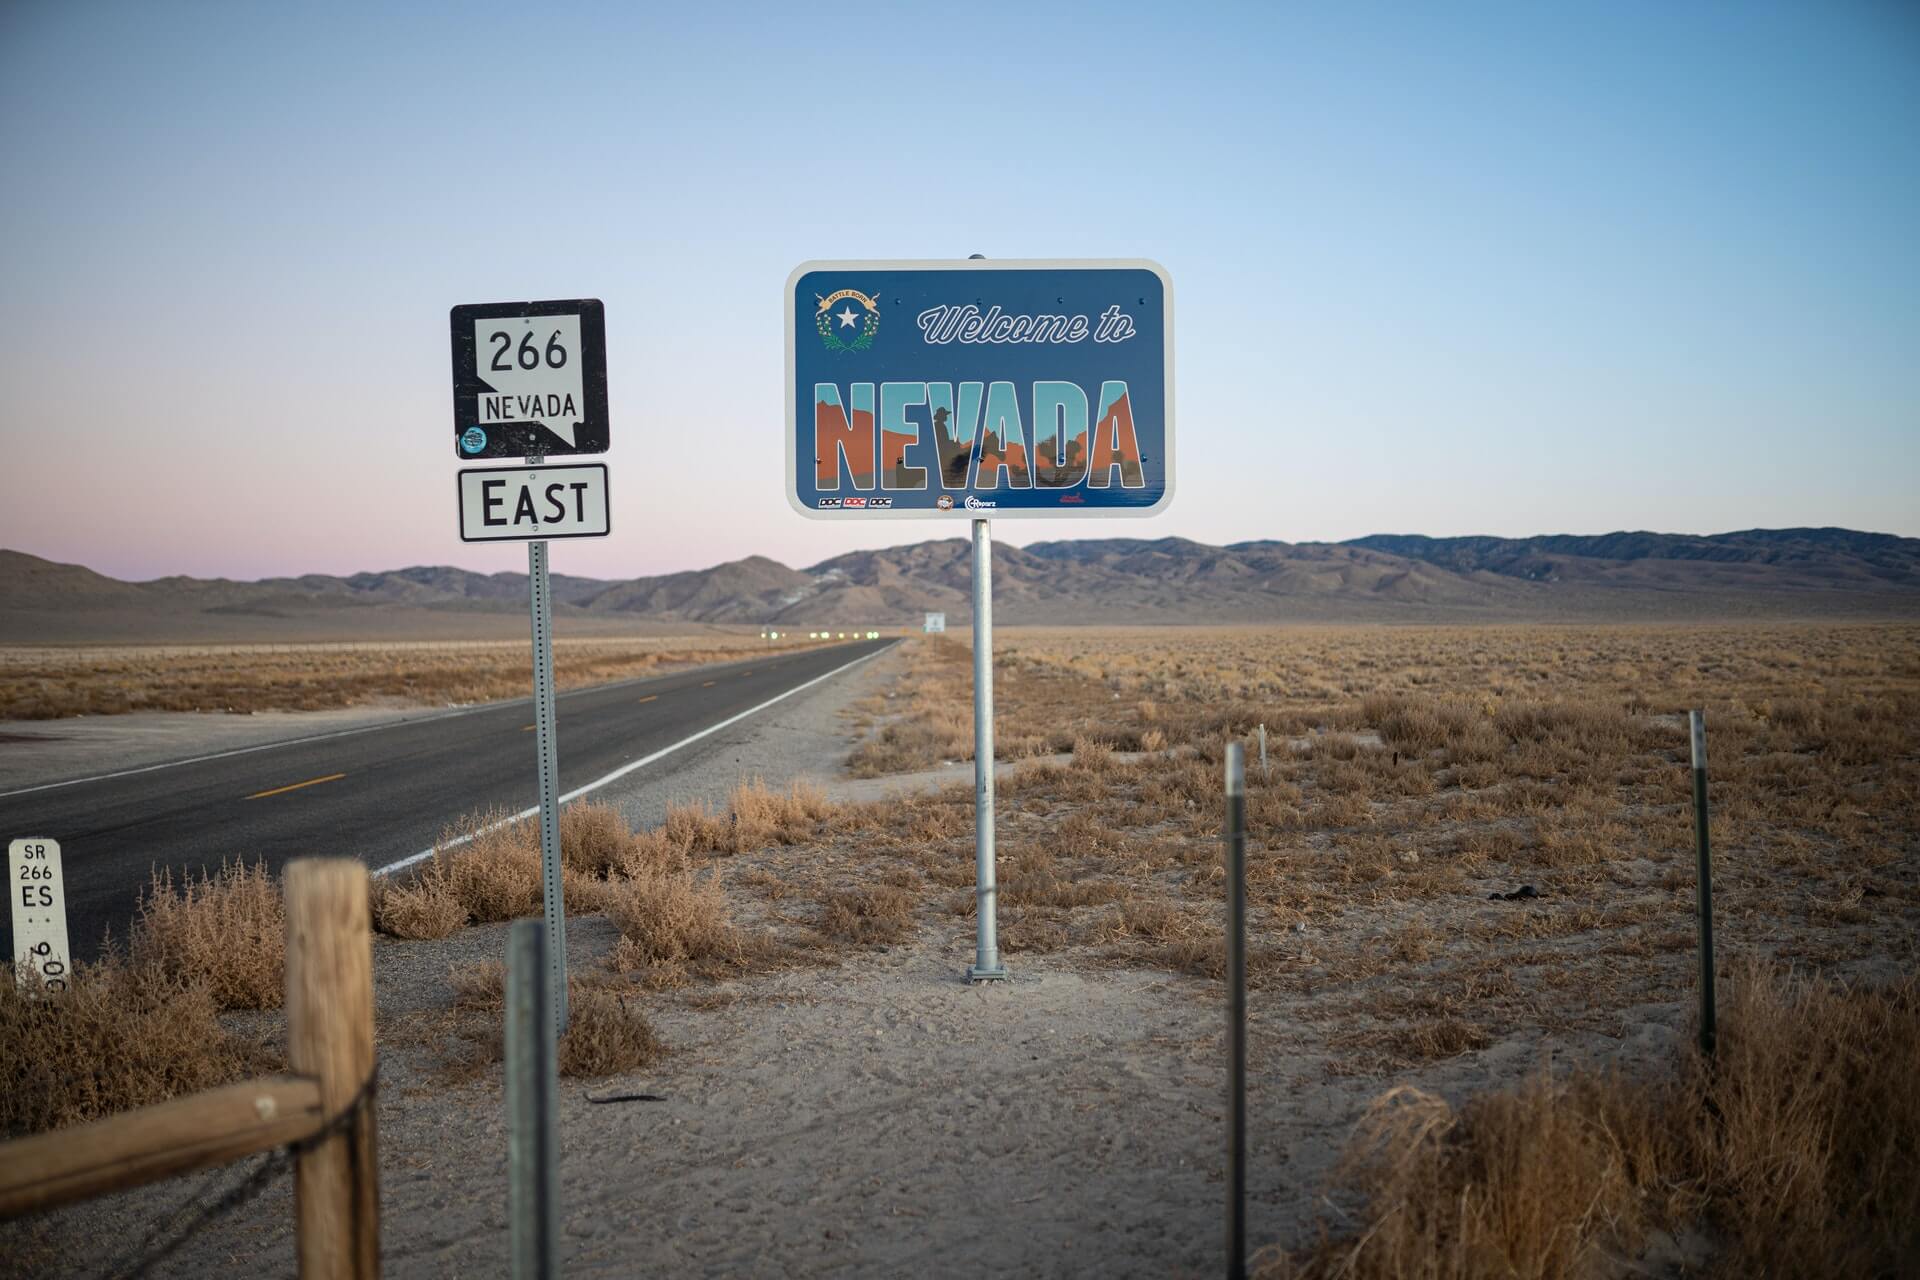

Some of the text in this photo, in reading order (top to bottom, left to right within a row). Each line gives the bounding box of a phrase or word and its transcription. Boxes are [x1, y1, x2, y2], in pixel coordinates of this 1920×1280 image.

[828, 290, 868, 304] BATTLE BORN
[917, 305, 1136, 344] Welcome to
[489, 329, 567, 371] 266
[486, 393, 577, 420] NEVADA
[815, 381, 1146, 491] NEVADA
[482, 479, 588, 526] EAST
[24, 845, 46, 860] SR
[20, 865, 52, 880] 266
[22, 886, 53, 907] ES
